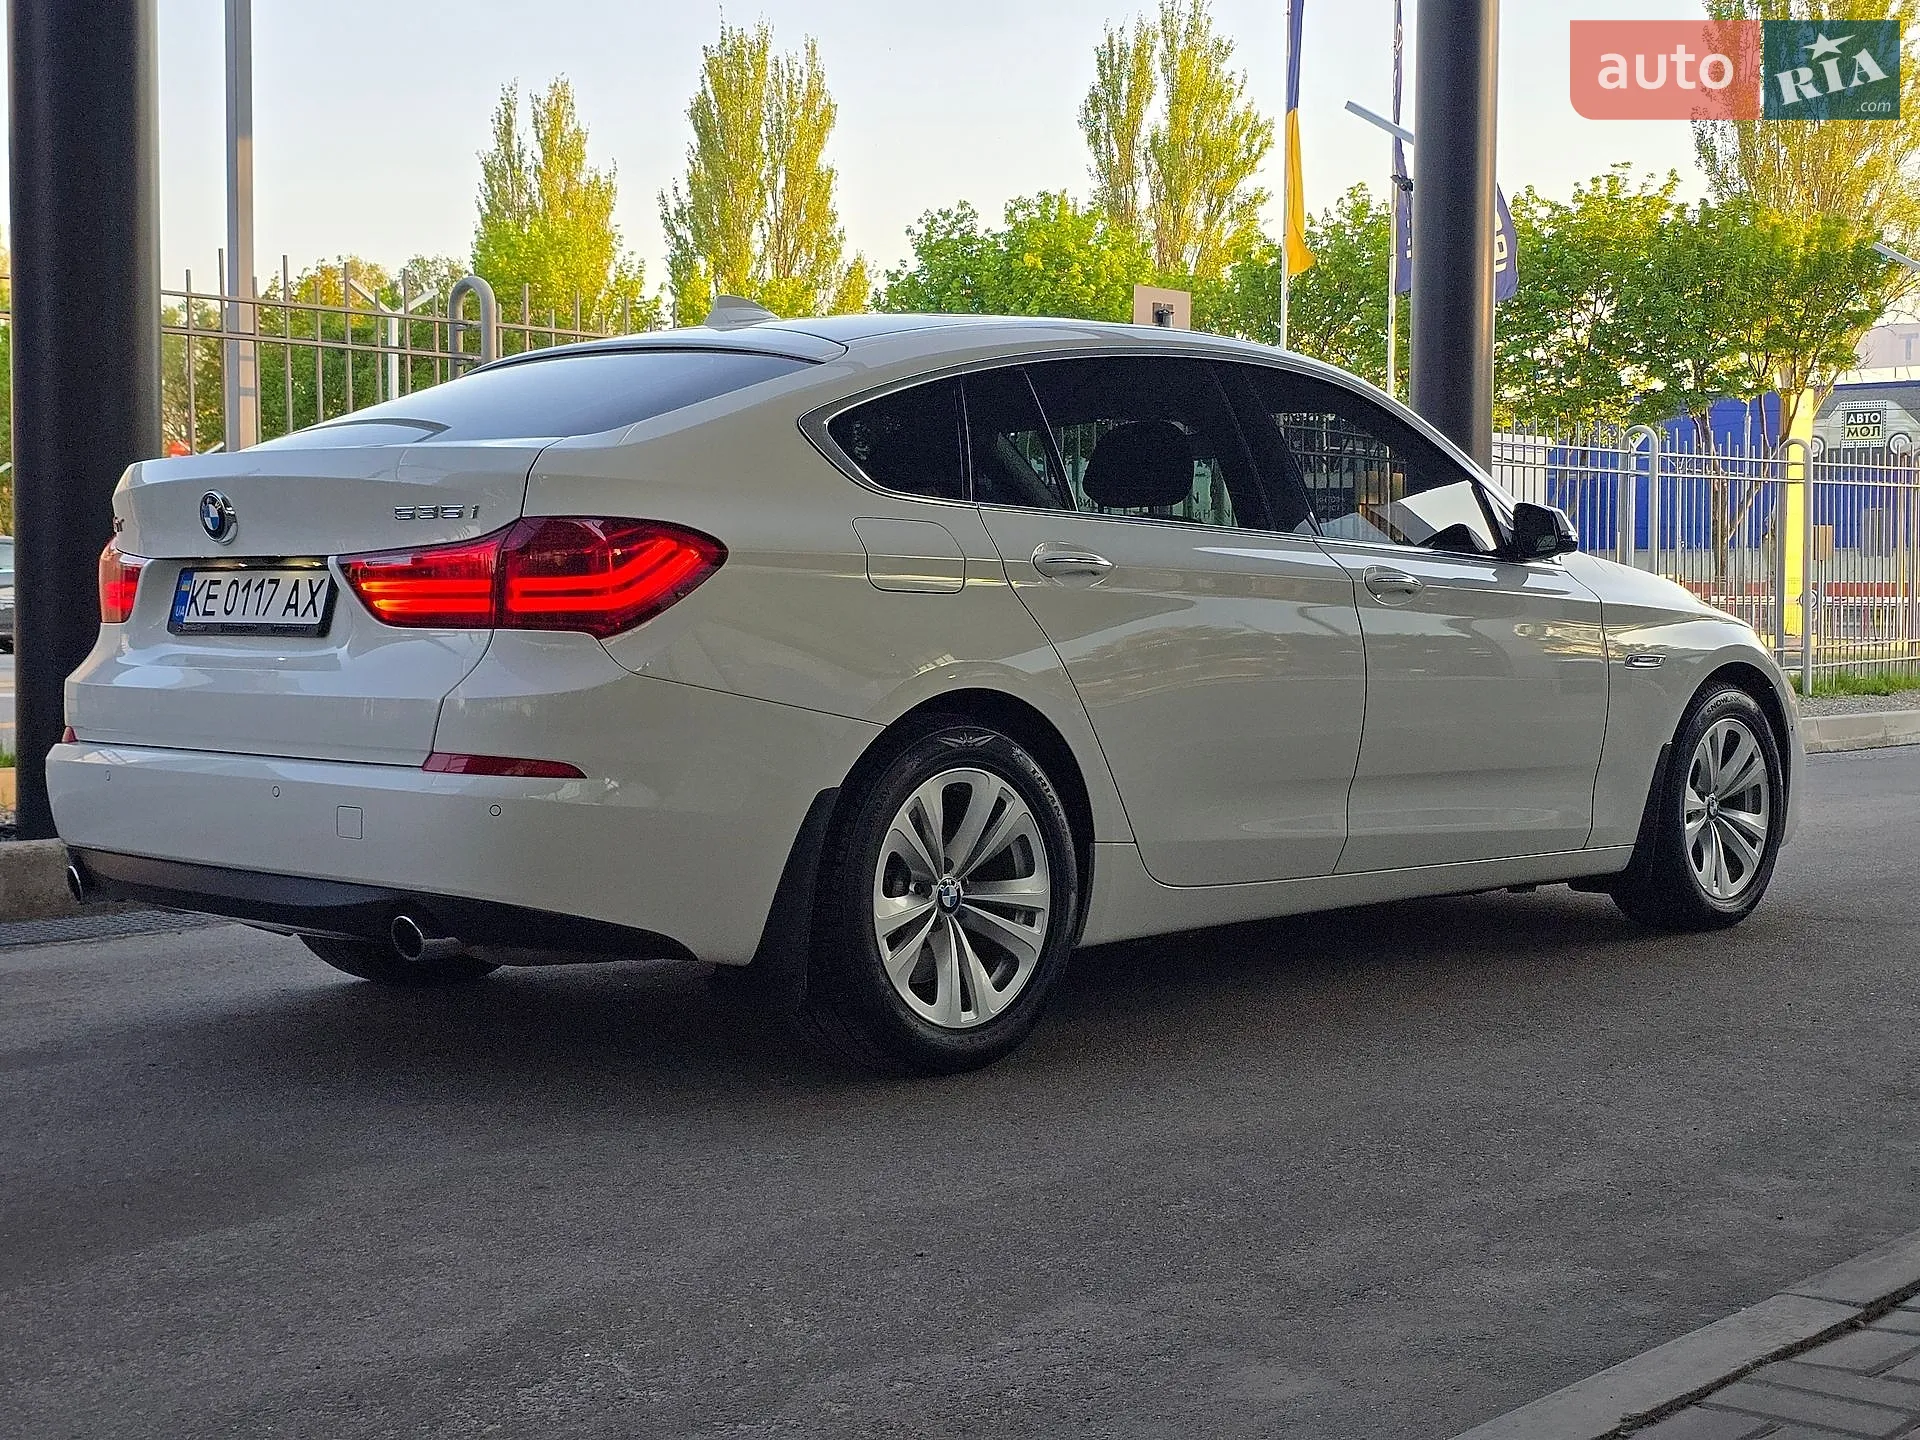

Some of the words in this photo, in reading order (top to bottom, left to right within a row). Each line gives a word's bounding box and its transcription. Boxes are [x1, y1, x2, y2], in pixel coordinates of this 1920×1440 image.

[1847, 412, 1881, 424] АВТО
[1846, 425, 1881, 438] МОЛ
[186, 579, 222, 617] KE
[223, 578, 281, 616] 0117
[282, 578, 326, 618] AX
[175, 606, 185, 617] UA
